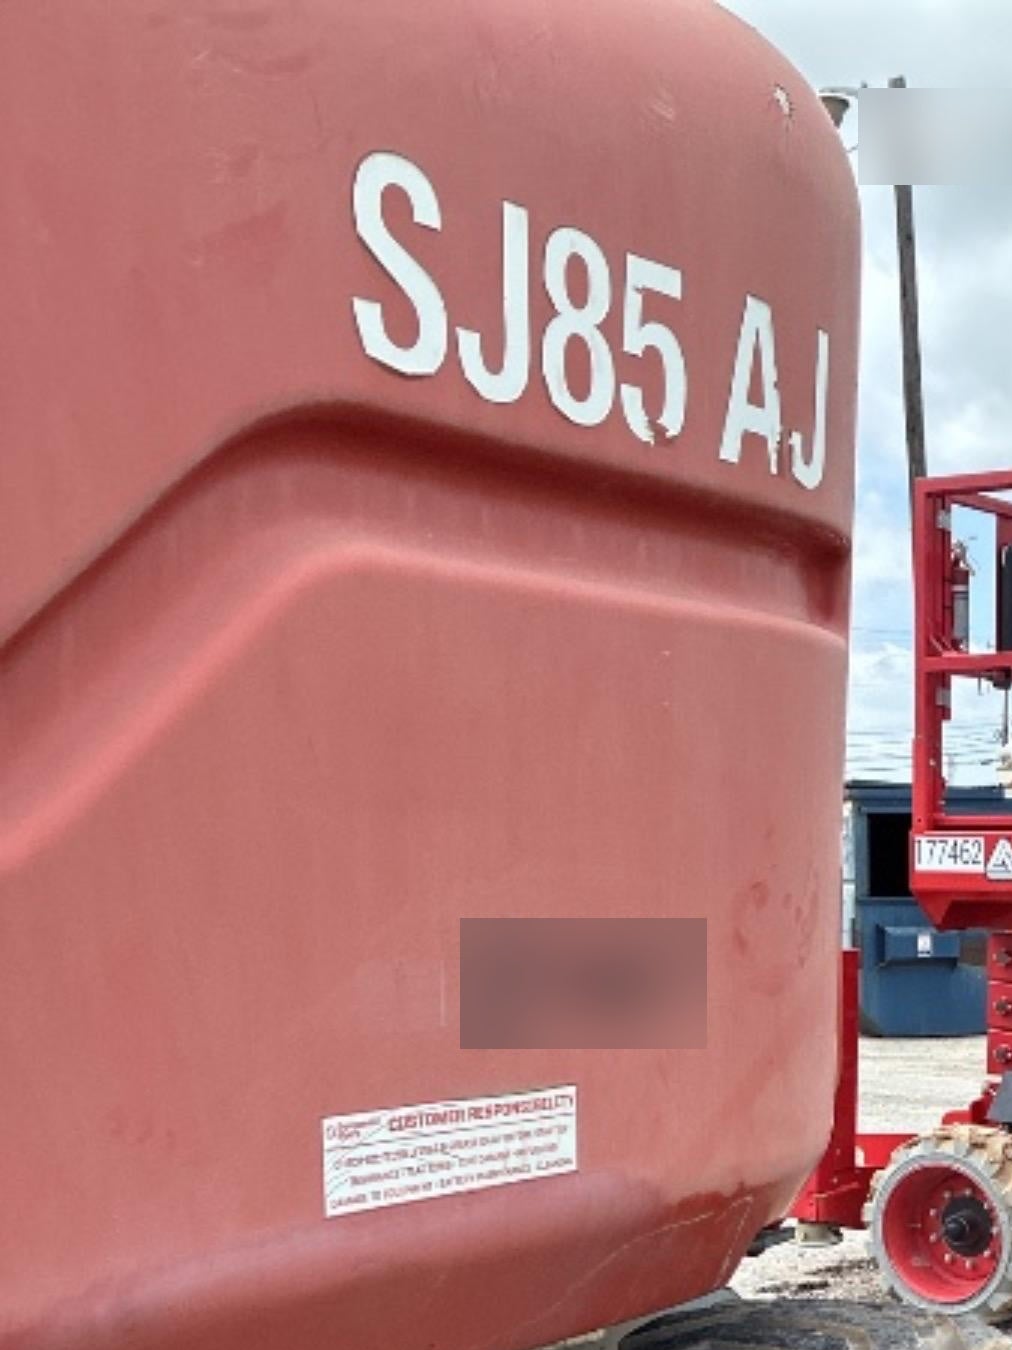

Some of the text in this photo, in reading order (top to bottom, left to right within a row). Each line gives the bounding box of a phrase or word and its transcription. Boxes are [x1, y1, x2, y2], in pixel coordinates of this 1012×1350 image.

[352, 150, 829, 490] SJ85 AJ
[916, 838, 983, 866] 177462
